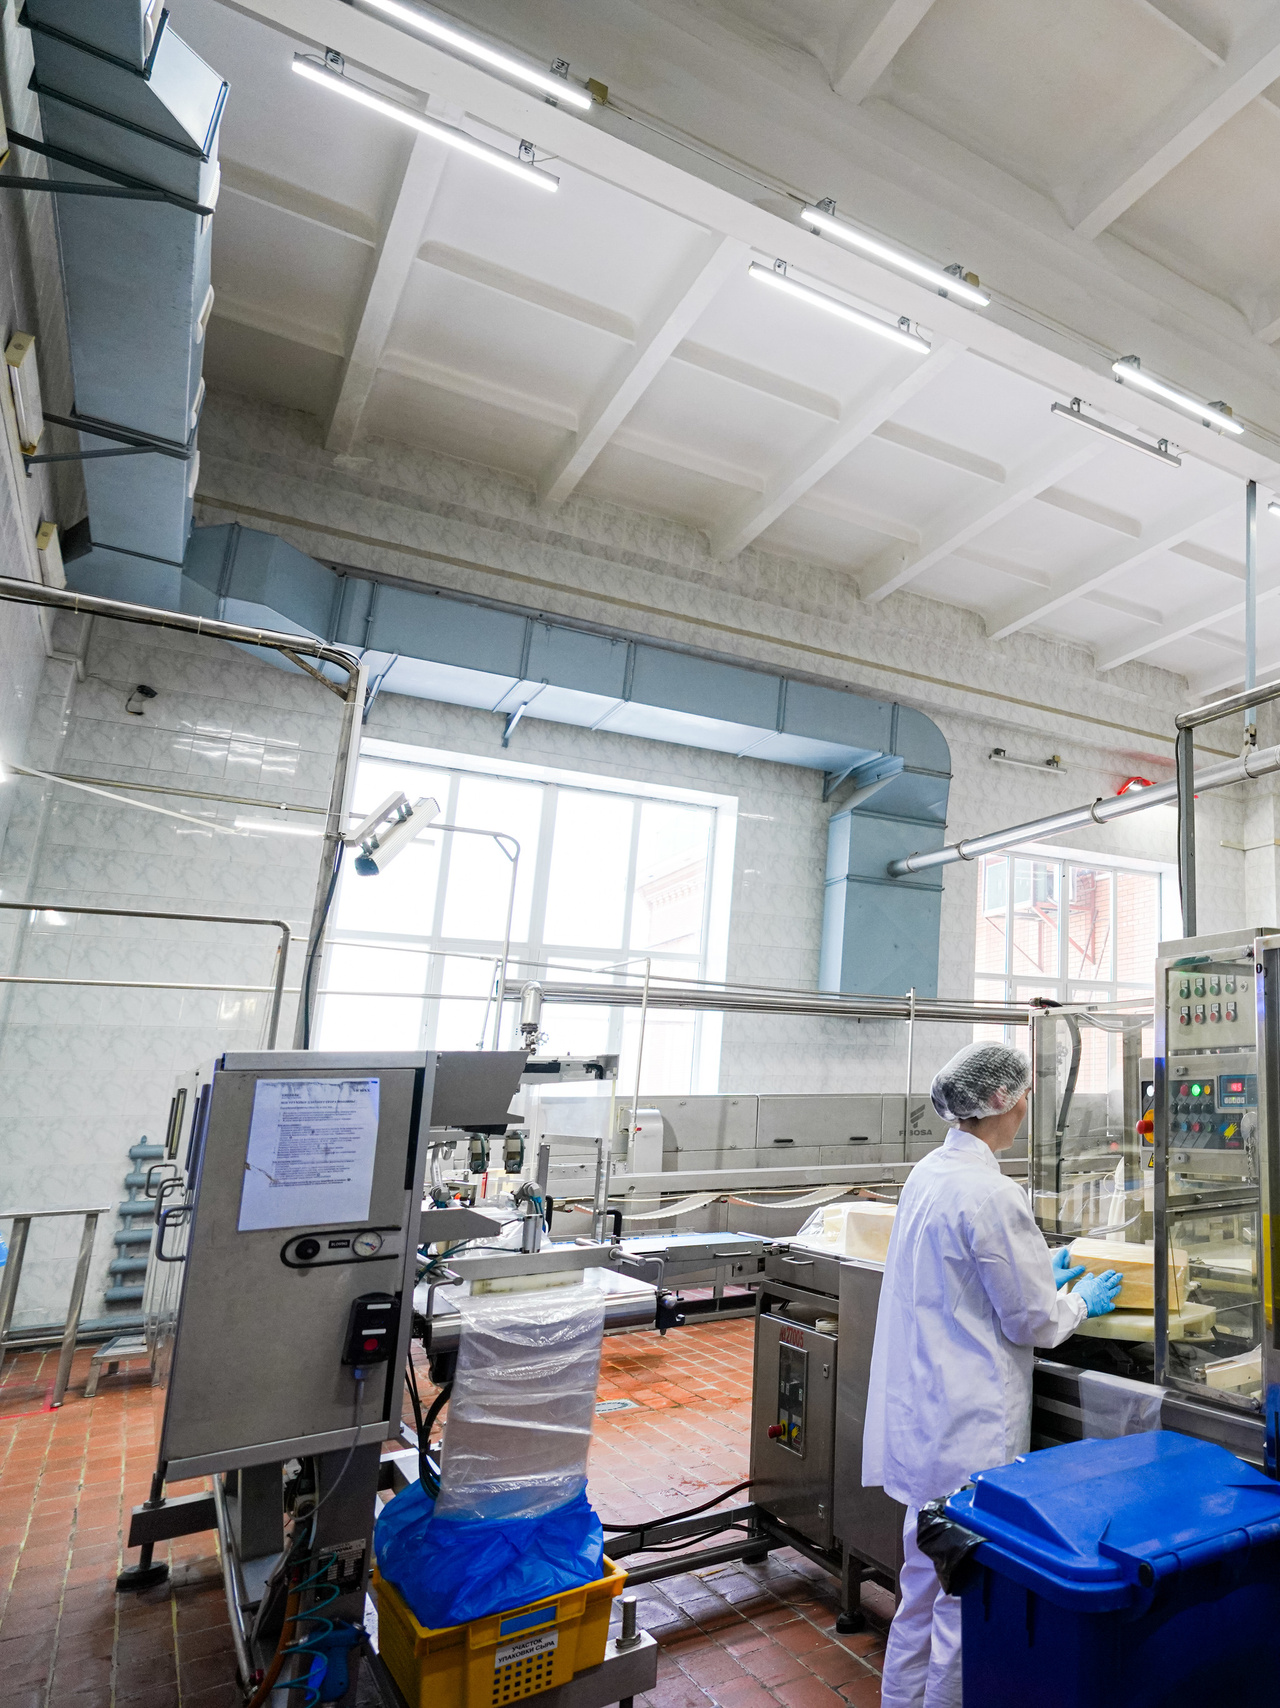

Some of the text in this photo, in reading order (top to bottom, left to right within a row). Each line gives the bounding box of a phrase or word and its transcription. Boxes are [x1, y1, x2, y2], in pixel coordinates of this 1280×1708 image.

[498, 1640, 555, 1663] УПАКОВКИ СЫРА
[511, 1638, 543, 1652] УЧАСТОК
